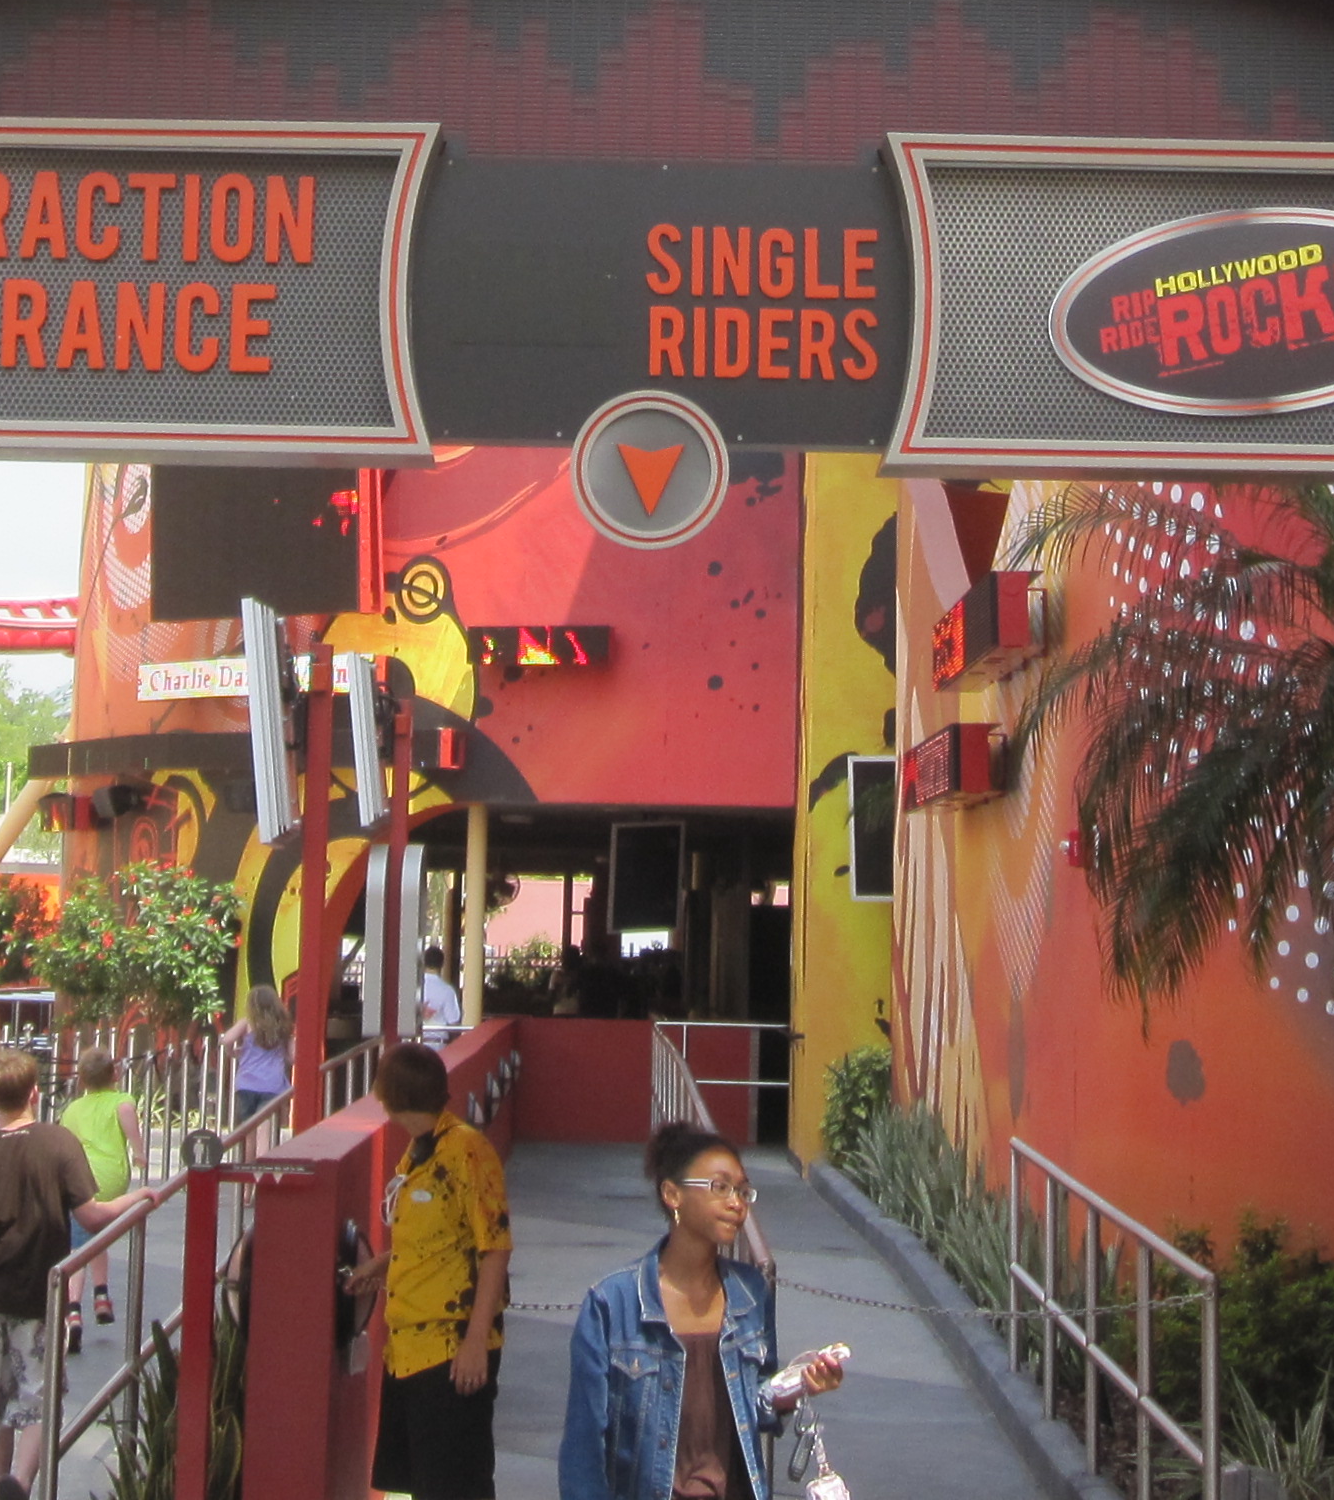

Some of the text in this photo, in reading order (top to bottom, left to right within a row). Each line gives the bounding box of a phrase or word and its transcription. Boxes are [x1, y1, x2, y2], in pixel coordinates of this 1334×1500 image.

[645, 225, 877, 299] SINGLE
[1155, 244, 1323, 297] HOLLYWOOD
[1111, 289, 1156, 322] RIP
[648, 307, 878, 381] RIDERS
[1100, 317, 1159, 353] RIDE
[150, 667, 212, 692] Charlie
